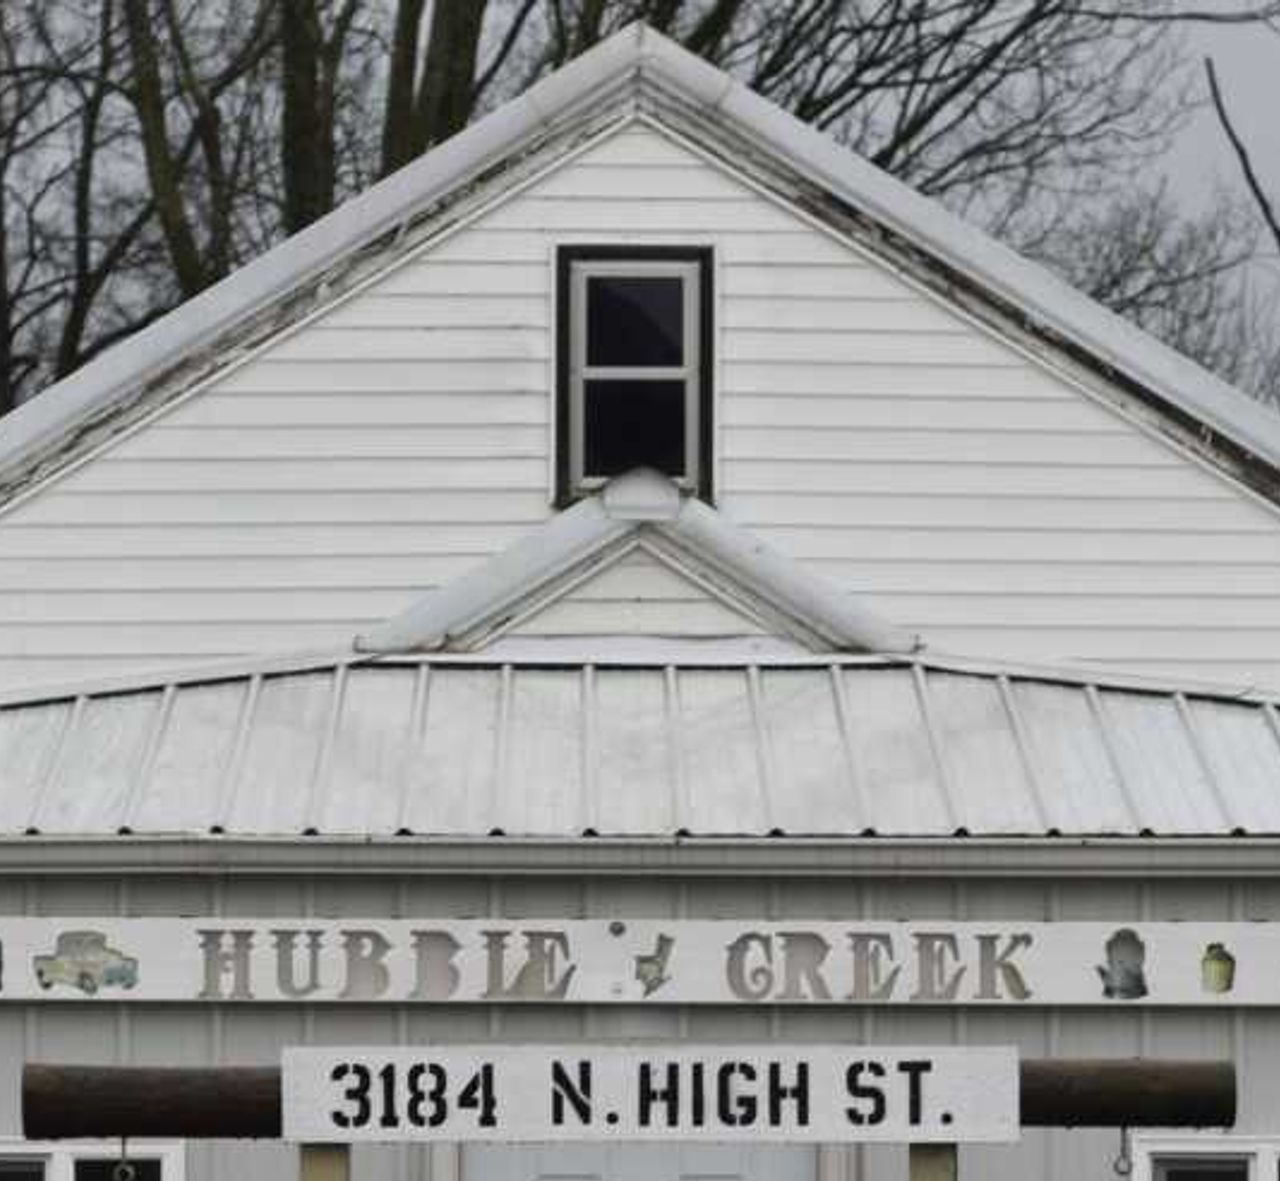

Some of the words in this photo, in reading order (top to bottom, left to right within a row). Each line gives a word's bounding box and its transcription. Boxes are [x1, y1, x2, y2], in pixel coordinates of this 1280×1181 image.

[195, 928, 577, 1000] HUBBLE
[724, 930, 1034, 1000] CREEK
[331, 1062, 498, 1128] 3184
[845, 1060, 954, 1126] ST.
